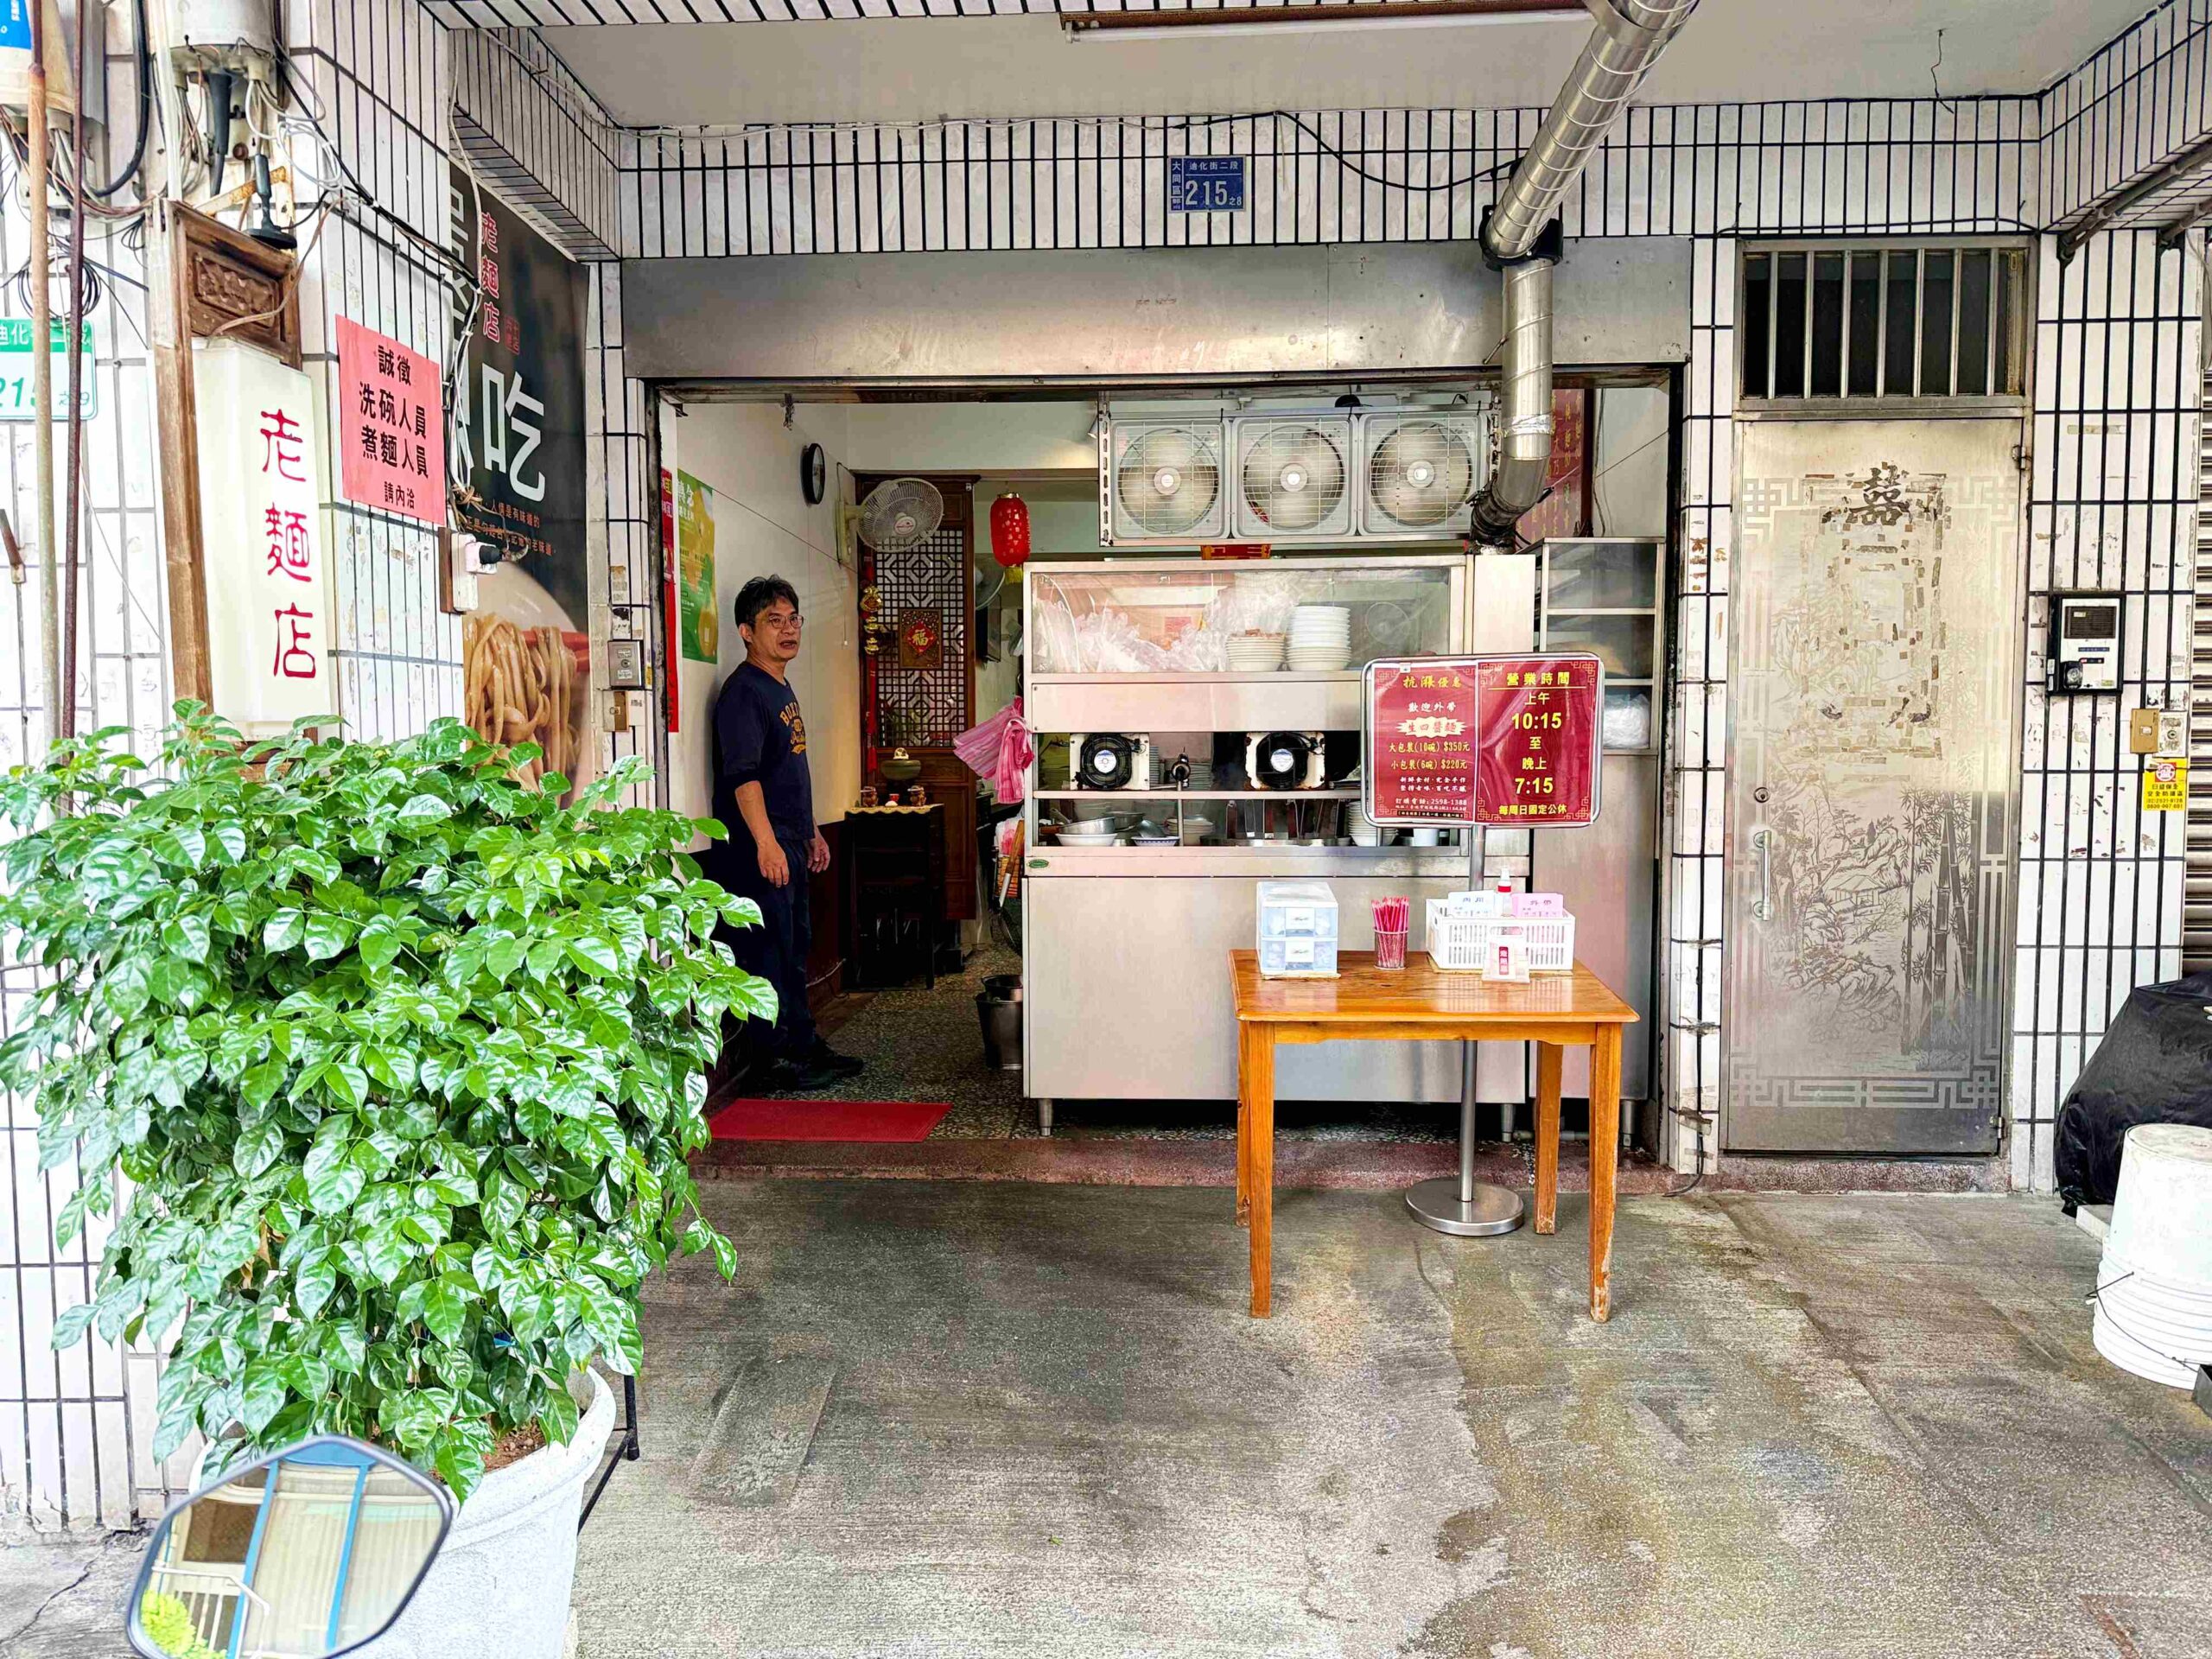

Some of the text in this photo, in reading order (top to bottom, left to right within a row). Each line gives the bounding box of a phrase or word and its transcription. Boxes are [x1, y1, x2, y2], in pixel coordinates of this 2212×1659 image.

[1189, 162, 1238, 170] 迪化街二段
[1172, 162, 1181, 195] 大同區
[1185, 180, 1228, 206] 215
[377, 345, 412, 386] 誠徵
[359, 380, 428, 439] 洗碗人員
[361, 424, 429, 479] 煮麵人員
[384, 480, 416, 510] 請內洽
[260, 408, 316, 679] 老麵店
[1507, 671, 1570, 686] 營業時間
[1524, 691, 1550, 705] 上午
[1511, 711, 1562, 729] 10:15
[1529, 736, 1541, 749] 至
[1522, 756, 1547, 770] 晚上
[1515, 776, 1554, 794] 7:15
[1498, 804, 1567, 815] 每周日固定公休
